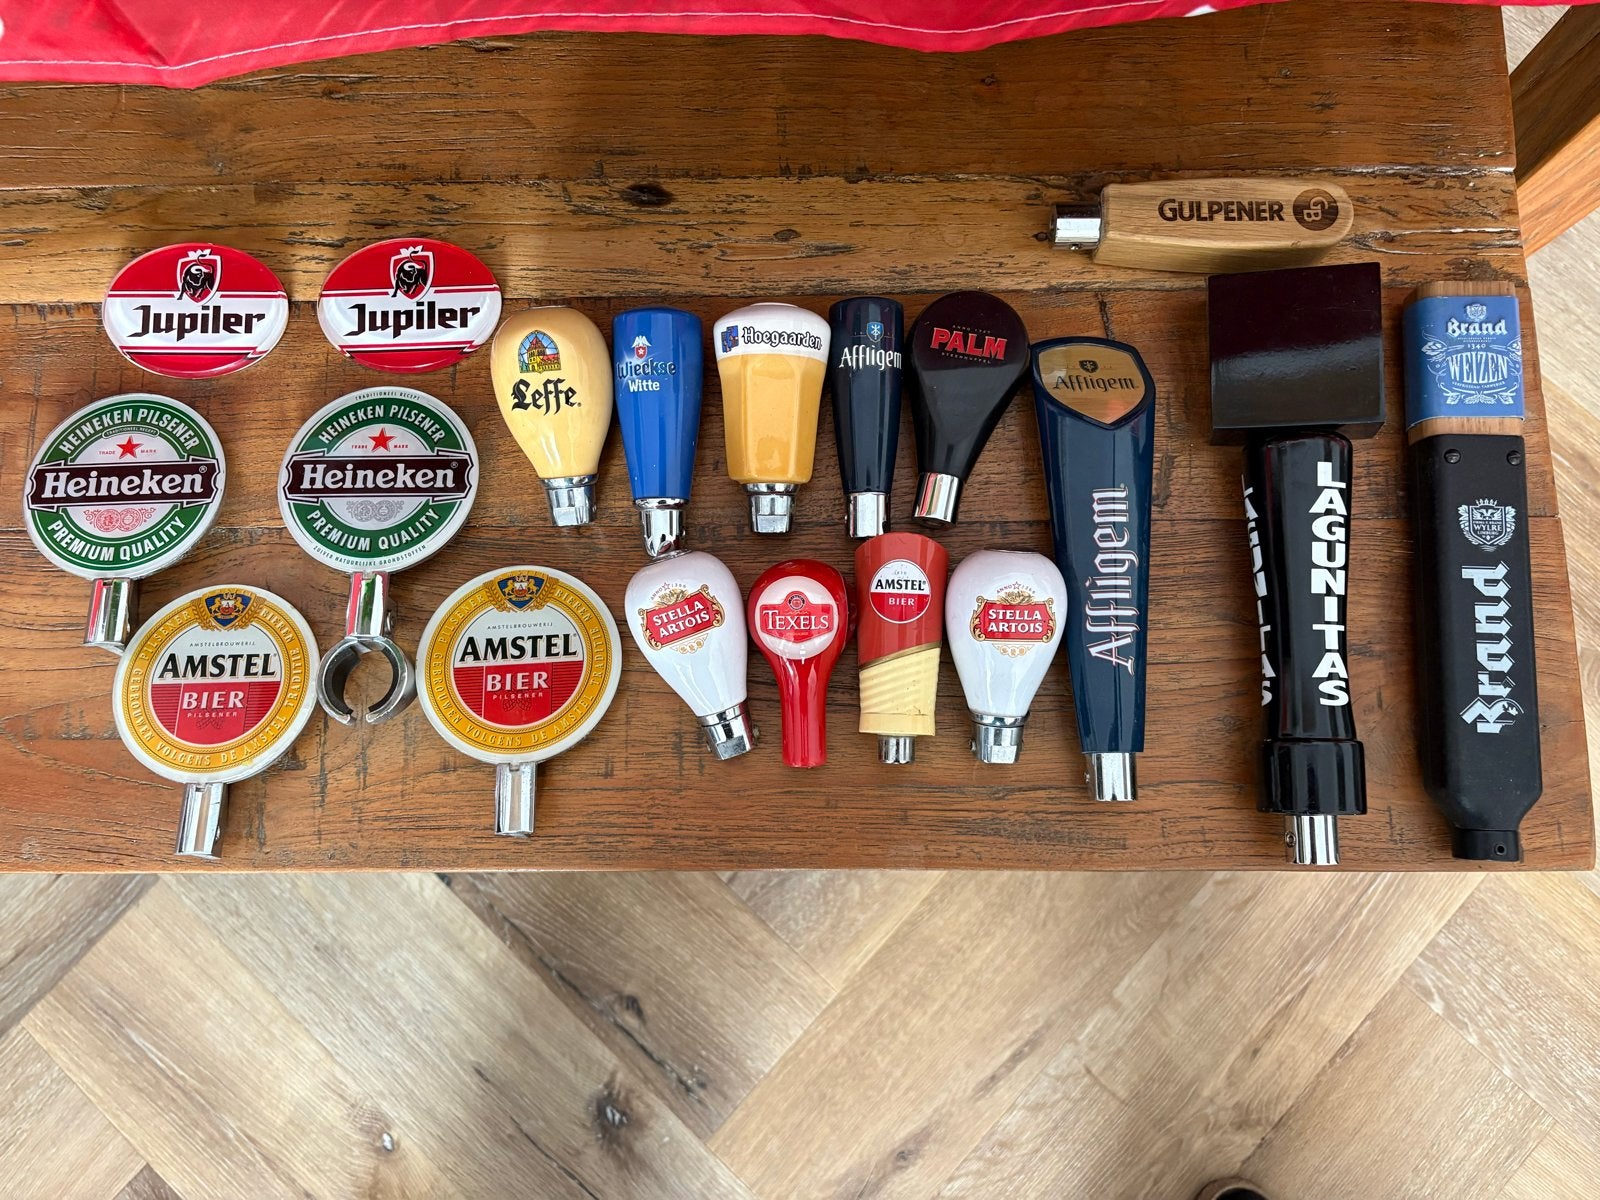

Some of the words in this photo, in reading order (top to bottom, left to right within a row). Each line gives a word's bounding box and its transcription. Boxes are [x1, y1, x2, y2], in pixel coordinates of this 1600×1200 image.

[1157, 199, 1285, 222] GULPENER
[127, 304, 266, 342] Jupiler
[344, 301, 480, 339] Jupiler
[1447, 317, 1508, 338] Brand
[741, 326, 822, 350] Hoegaarden
[930, 327, 1008, 361] PALM
[617, 358, 677, 380] Wieckse
[839, 344, 902, 371] Affligem
[1447, 352, 1508, 384] WEIZEN
[628, 379, 660, 393] Witte
[1053, 374, 1135, 392] Affligem
[511, 378, 577, 416] Leffe
[58, 408, 133, 455] HEINEKEN
[136, 408, 200, 451] PILSENER
[318, 404, 385, 444] HEINEKEN
[389, 404, 446, 444] PILSENER
[41, 469, 204, 498] Heineken
[301, 463, 456, 489] Heineken
[47, 519, 115, 562] PREMIUM
[119, 515, 186, 561] QUALITY
[306, 509, 371, 552] PREMIUM
[378, 508, 441, 550] QUALITY
[875, 579, 924, 591] AMSTEL
[1086, 485, 1139, 676] Affligem
[1308, 461, 1349, 707] LAGUNITAS
[652, 600, 704, 627] STELLA
[888, 597, 915, 606] BIER
[988, 609, 1042, 621] STELLA
[438, 594, 486, 643] PILSENER
[554, 588, 593, 622] BIEREN
[659, 612, 710, 638] ARTOIS
[762, 610, 829, 630] TEXELS
[988, 622, 1043, 633] ARTOIS
[139, 610, 191, 661] PILSENER
[260, 607, 296, 643] BIEREN
[459, 633, 578, 662] AMSTEL
[158, 652, 276, 679] AMSTEL
[487, 671, 549, 692] BIER
[182, 690, 245, 710] BIER
[432, 652, 462, 725] GEBROUWEN
[465, 725, 522, 746] VOLGENS
[531, 730, 548, 743] DE
[554, 694, 596, 735] AMSTEL
[492, 692, 543, 700] PILSENER
[155, 741, 211, 766] VOLGENS
[221, 748, 238, 763] DE
[243, 714, 287, 757] AMSTEL
